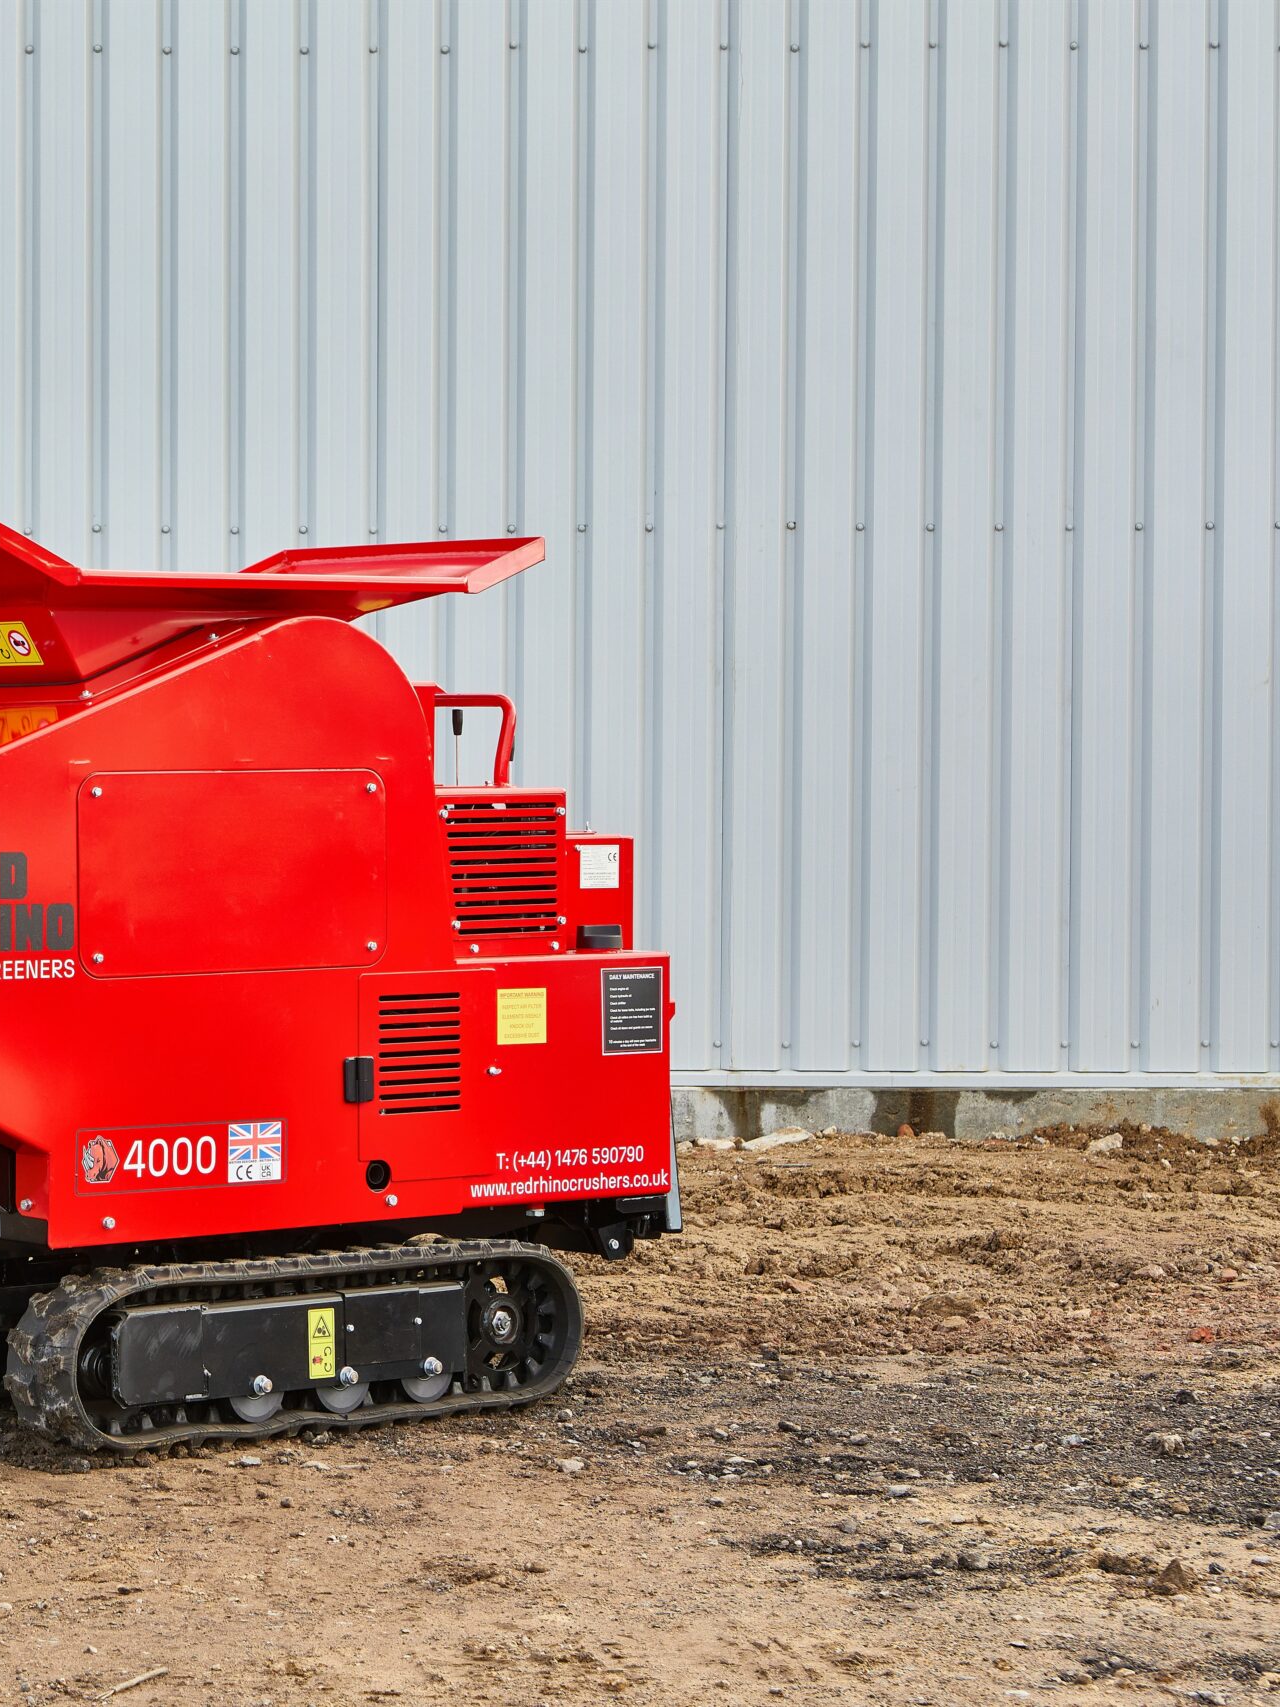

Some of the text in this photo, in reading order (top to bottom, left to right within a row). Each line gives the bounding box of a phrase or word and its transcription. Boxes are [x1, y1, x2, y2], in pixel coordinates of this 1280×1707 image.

[122, 1135, 217, 1178] 4000
[496, 1145, 644, 1172] T: (+44) 1476 590790
[470, 1168, 670, 1198] www.redrhinocrushers.co.uk
